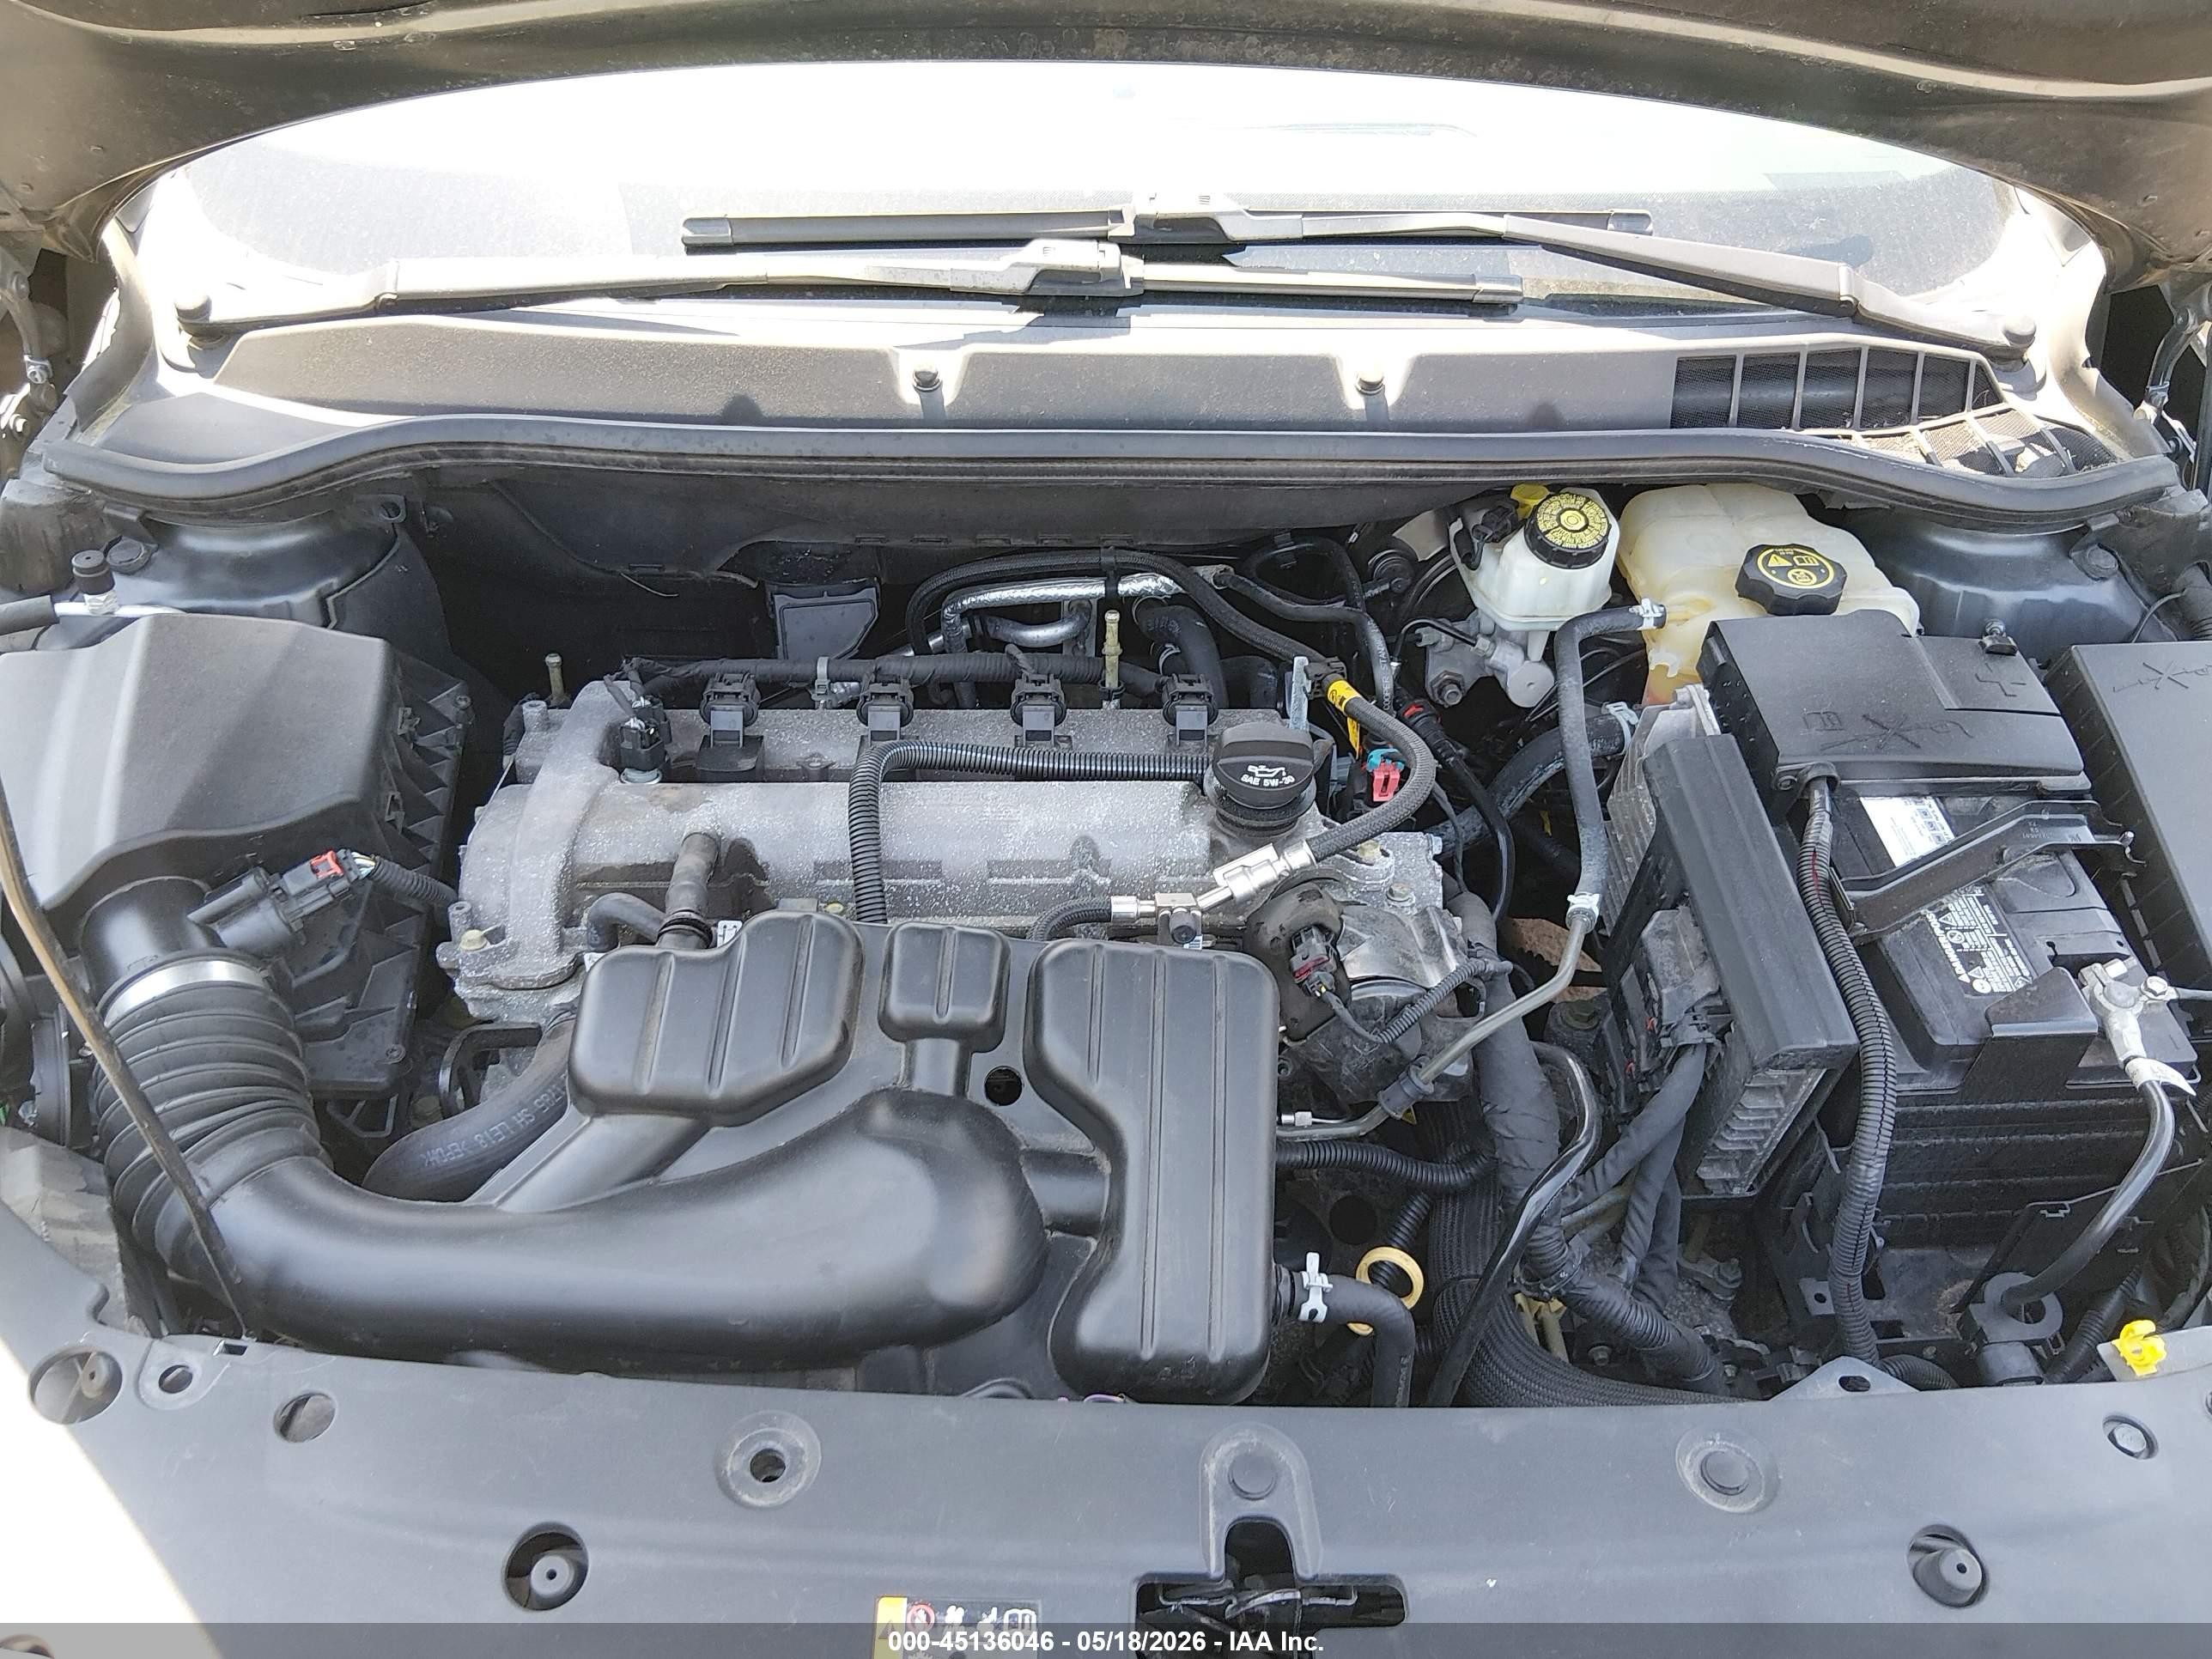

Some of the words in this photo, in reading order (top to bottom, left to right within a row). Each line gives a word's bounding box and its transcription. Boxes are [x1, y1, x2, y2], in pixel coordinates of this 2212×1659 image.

[1382, 676, 1390, 710] COOPER
[1241, 774, 1260, 786] SAE
[1263, 775, 1296, 787] 5W-30
